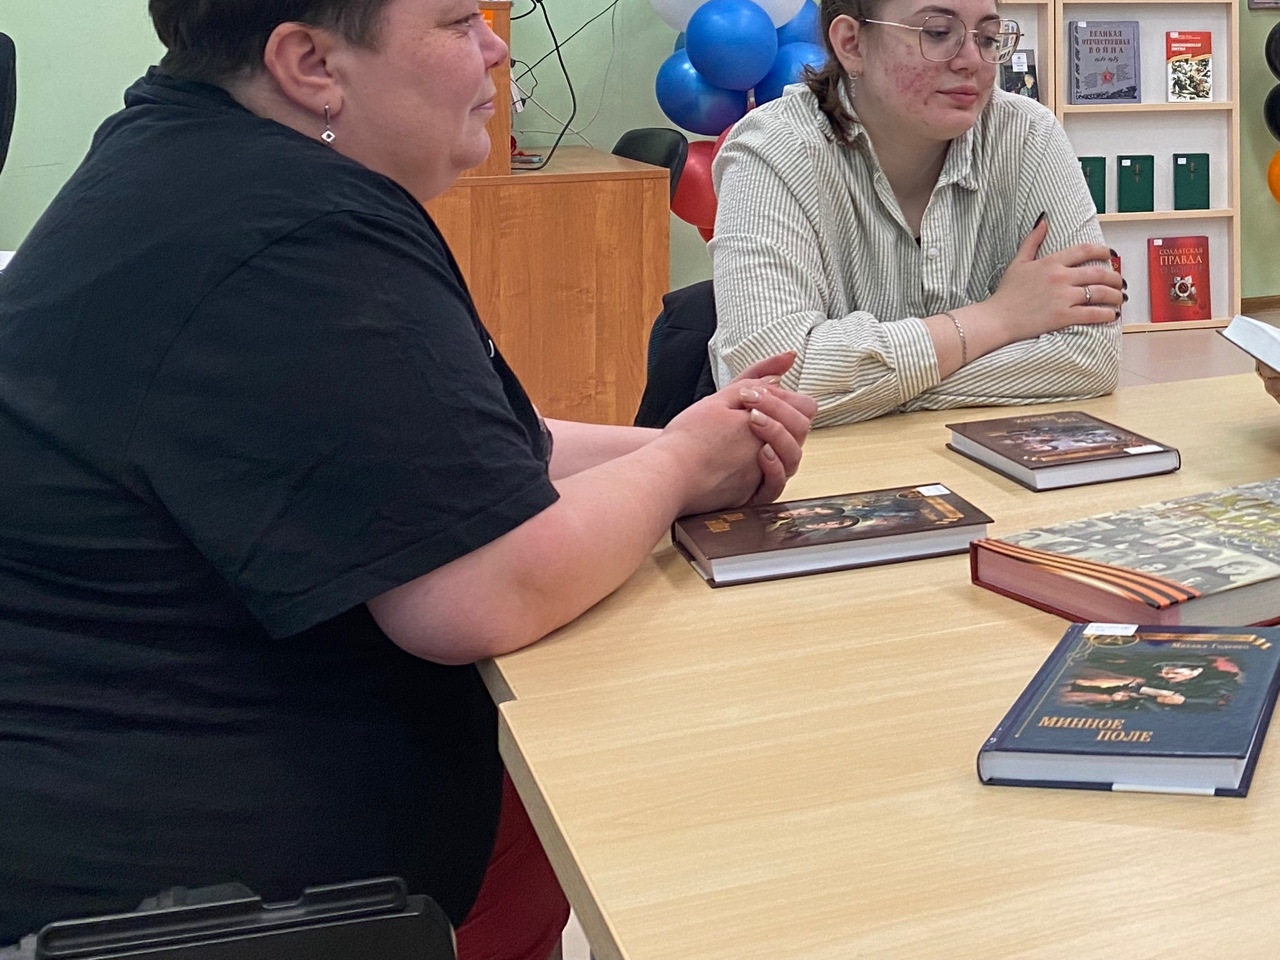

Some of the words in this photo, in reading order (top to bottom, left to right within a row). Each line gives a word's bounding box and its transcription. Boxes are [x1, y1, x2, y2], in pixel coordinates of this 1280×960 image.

[1089, 30, 1123, 38] ВЕЛИКАЯ
[1088, 46, 1124, 54] ВОЙНА
[1159, 247, 1203, 256] СОЛДАТСКАЯ
[1160, 255, 1203, 266] ПРАВДА
[1037, 716, 1126, 729] МИННОЕ
[1096, 729, 1154, 743] ПОЛЕ
